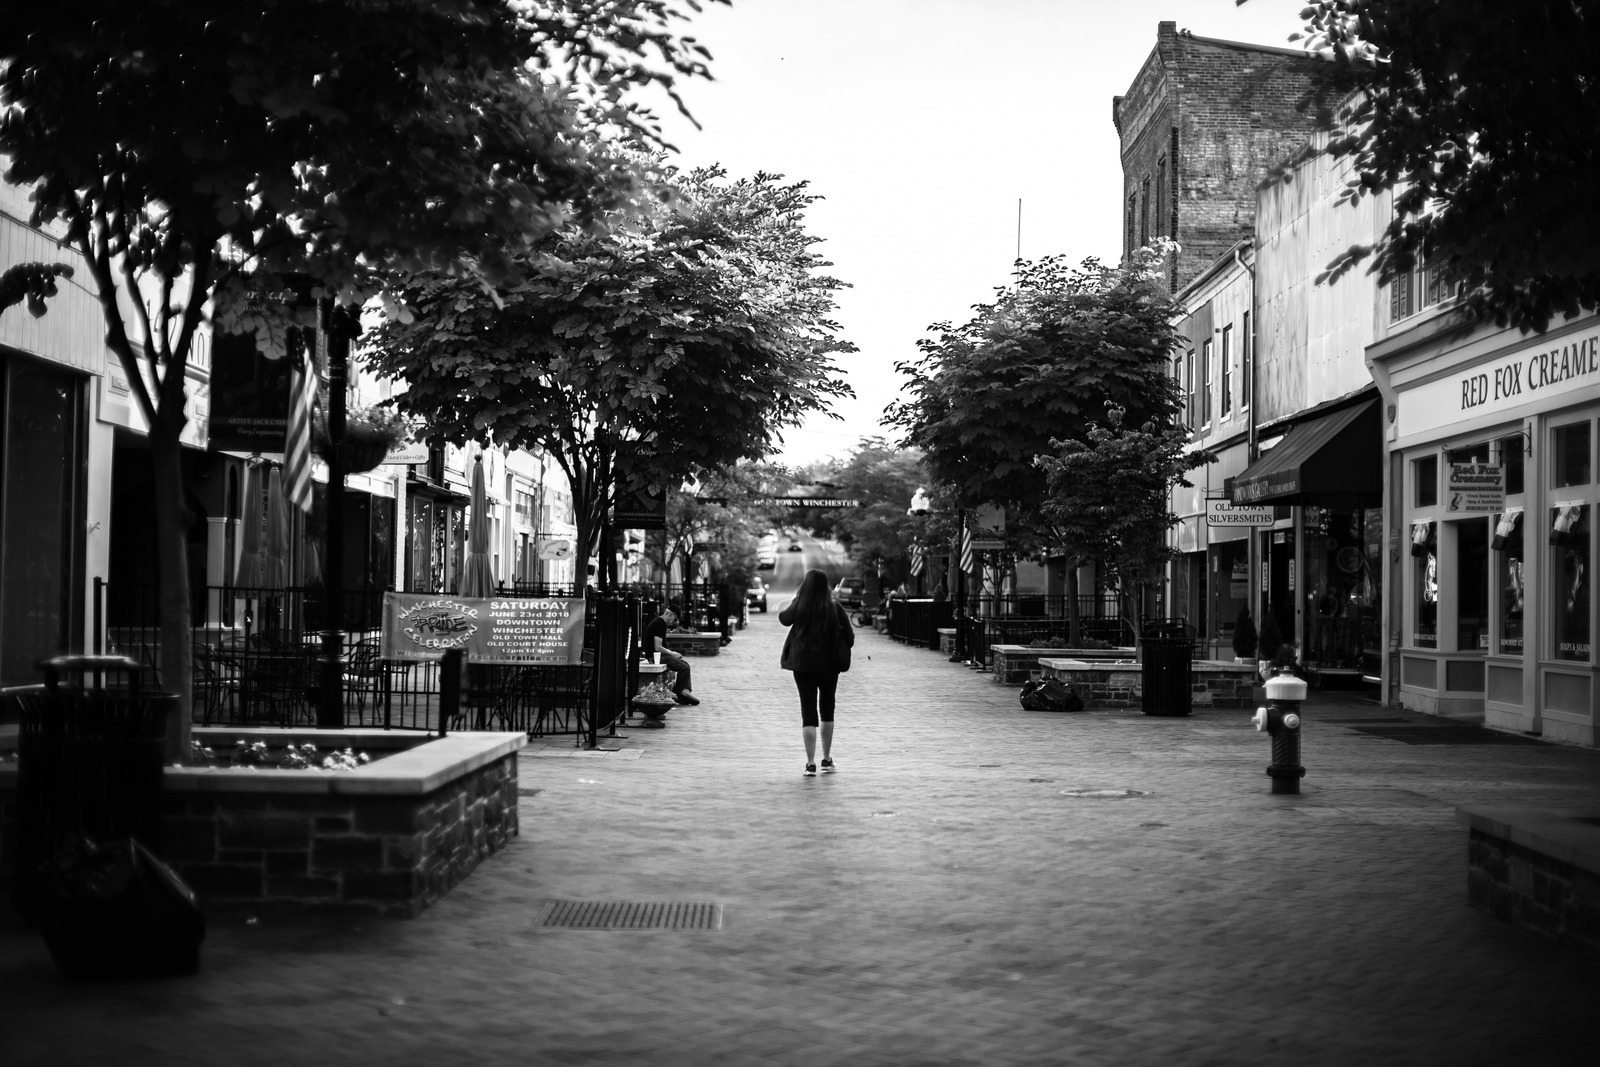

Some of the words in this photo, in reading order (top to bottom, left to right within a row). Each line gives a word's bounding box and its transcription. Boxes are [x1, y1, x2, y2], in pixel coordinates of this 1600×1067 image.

[1461, 373, 1488, 410] RED
[1495, 361, 1522, 400] FOX
[1528, 335, 1599, 390] CREAME
[1452, 464, 1476, 475] Red
[1478, 464, 1500, 475] Fox
[1450, 475, 1502, 485] Creamery
[802, 499, 859, 508] WINCHESTER
[1215, 503, 1234, 512] OLD
[1208, 514, 1273, 523] SILVERSMITHS
[490, 601, 569, 610] SATURDAY
[409, 611, 468, 635] PRIDE
